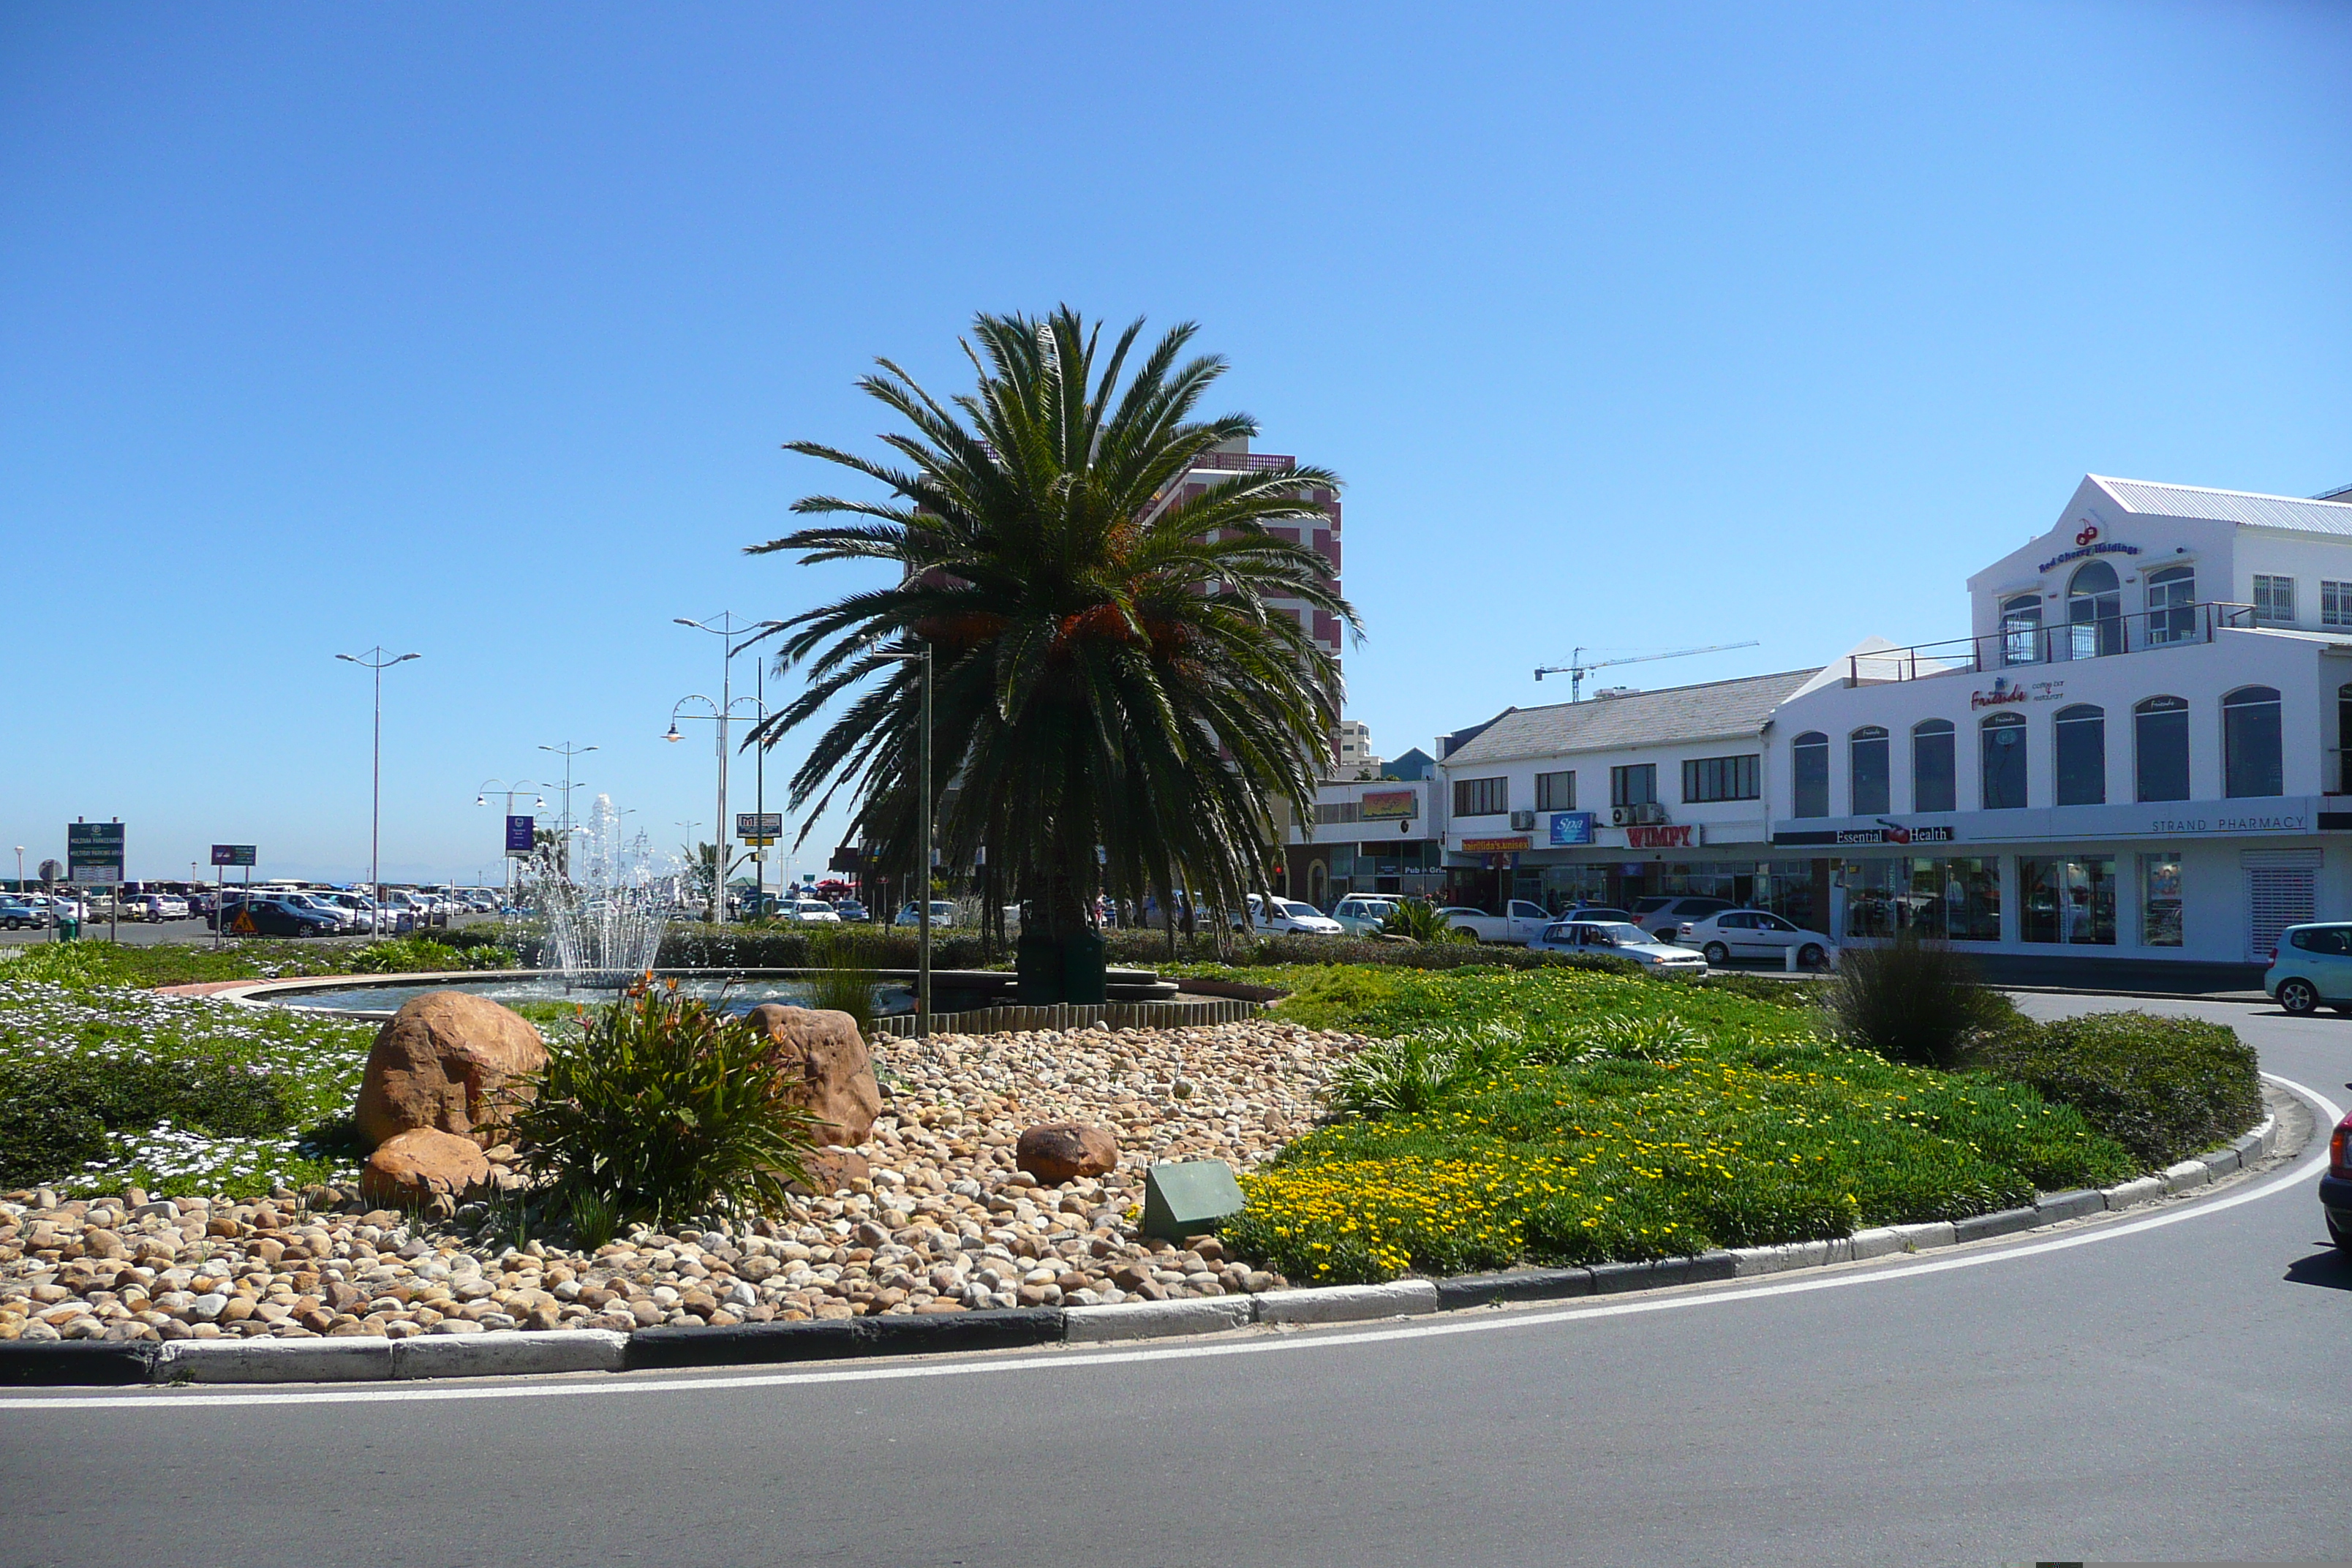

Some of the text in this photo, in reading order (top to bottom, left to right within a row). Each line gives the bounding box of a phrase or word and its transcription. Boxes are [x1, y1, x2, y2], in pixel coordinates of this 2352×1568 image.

[2038, 542, 2138, 573] Red Cherry Holdings
[1556, 818, 1583, 833] Spa
[2152, 816, 2304, 832] STRAND PHARMACY
[1626, 825, 1692, 848] WIMPY
[1836, 828, 1947, 843] Essential Health
